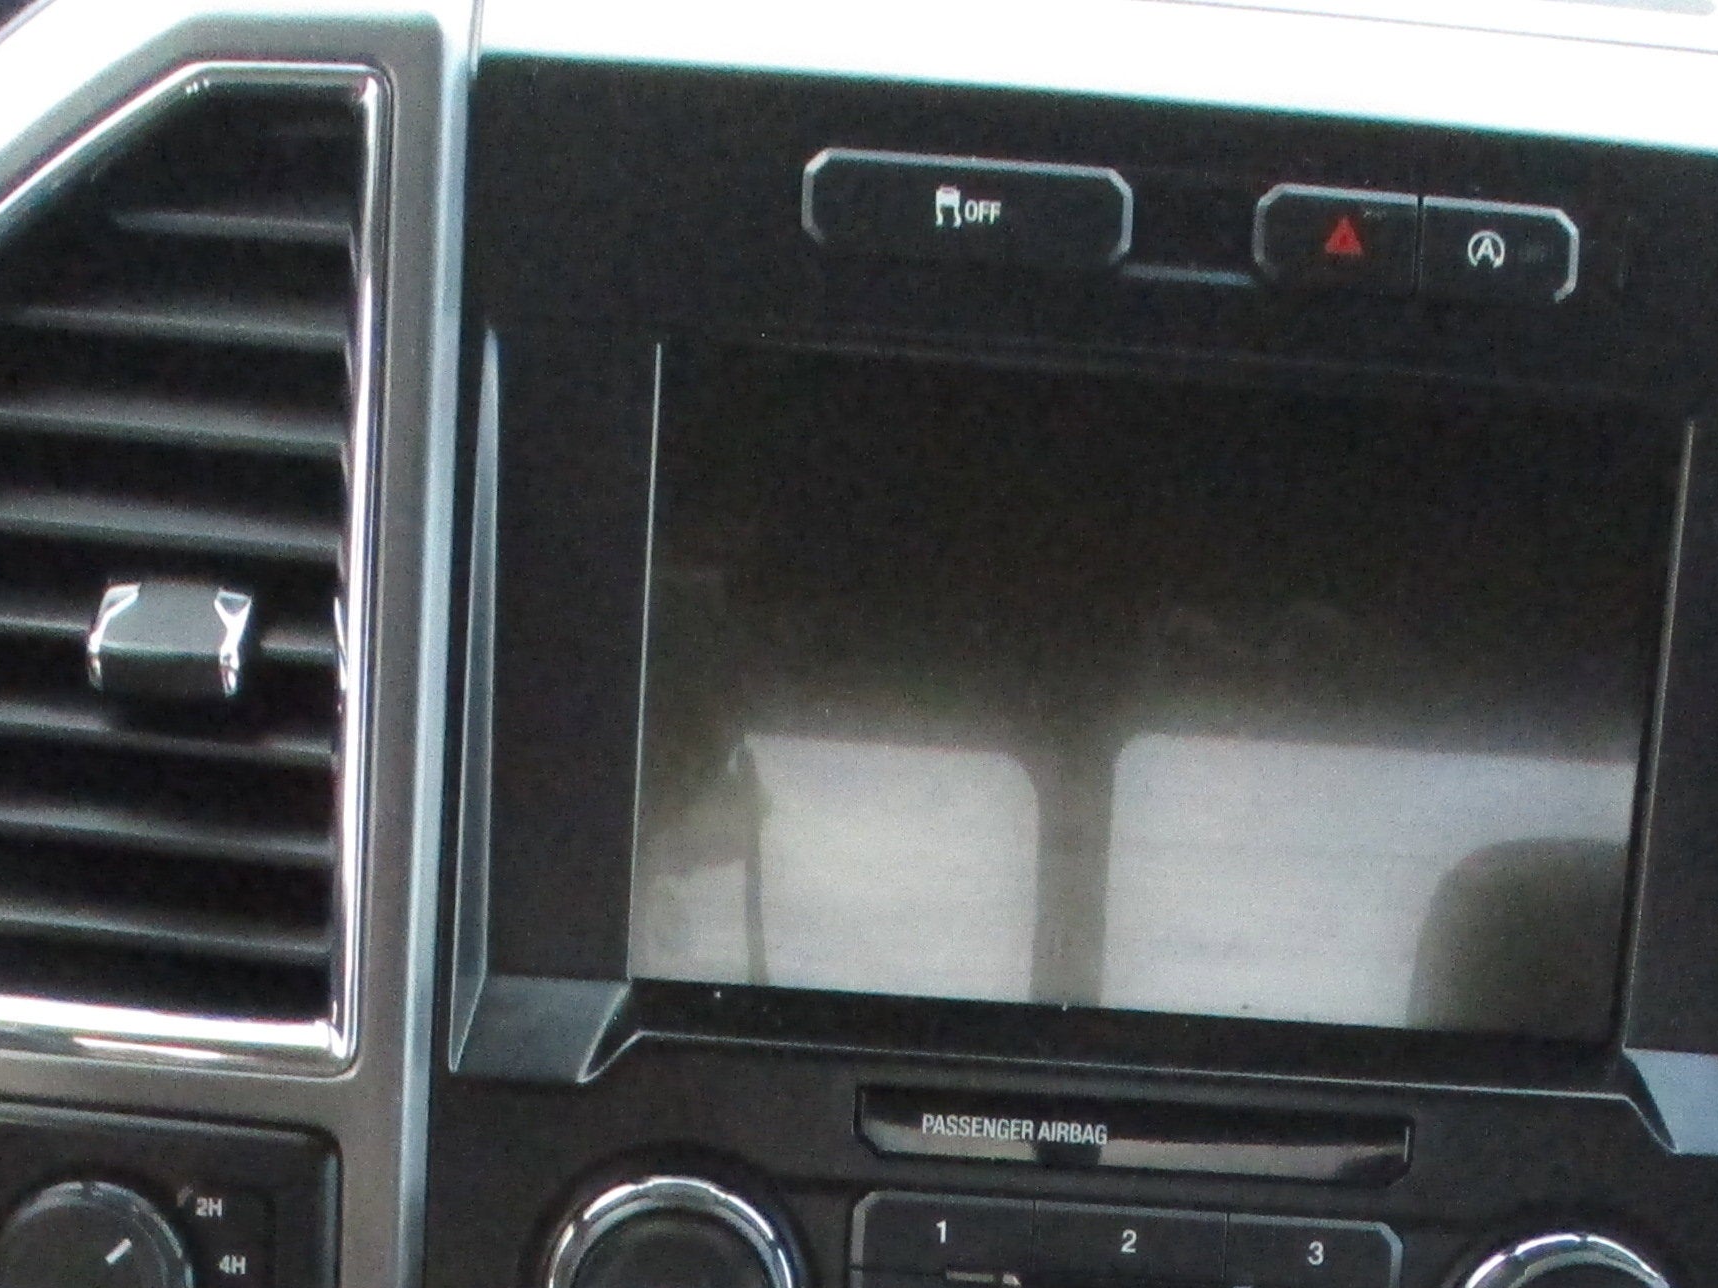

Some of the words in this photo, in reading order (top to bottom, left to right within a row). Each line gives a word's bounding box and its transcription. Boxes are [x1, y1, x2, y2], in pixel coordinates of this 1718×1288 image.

[964, 199, 1001, 223] OFF
[921, 1112, 1034, 1140] PASSENGER
[1037, 1120, 1109, 1146] AIRBAG
[195, 1197, 223, 1217] 2H
[936, 1220, 947, 1243] 1
[1120, 1229, 1138, 1254] 2
[218, 1255, 247, 1275] 4H
[1307, 1240, 1324, 1266] 3
